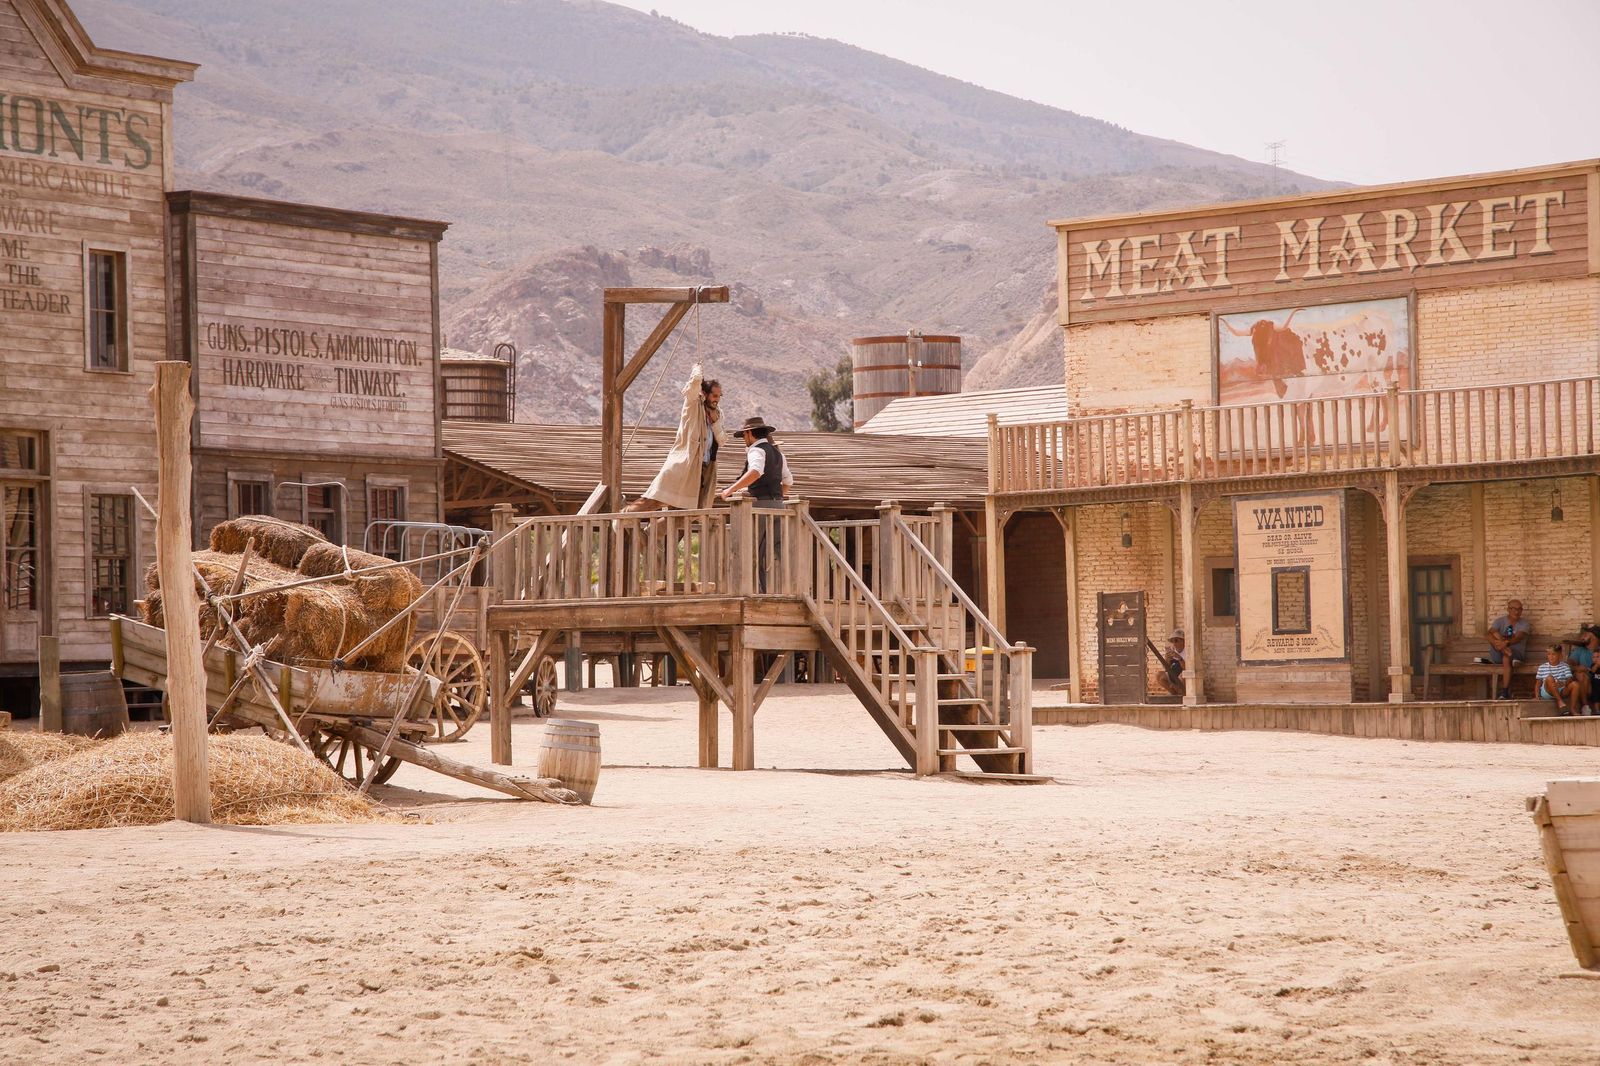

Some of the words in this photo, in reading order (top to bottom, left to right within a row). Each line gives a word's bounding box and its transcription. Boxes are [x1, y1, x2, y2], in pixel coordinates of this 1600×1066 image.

[1080, 225, 1242, 303] MEAT
[1274, 190, 1566, 283] MARKET
[5, 263, 41, 287] THE
[222, 358, 305, 391] HARDWARE
[333, 367, 406, 398] TINWARE.
[1253, 505, 1324, 530] WANTED
[1267, 534, 1282, 542] DEAD
[1284, 533, 1292, 541] OR
[1294, 532, 1312, 540] ALIVE
[1266, 638, 1294, 648] REWARD
